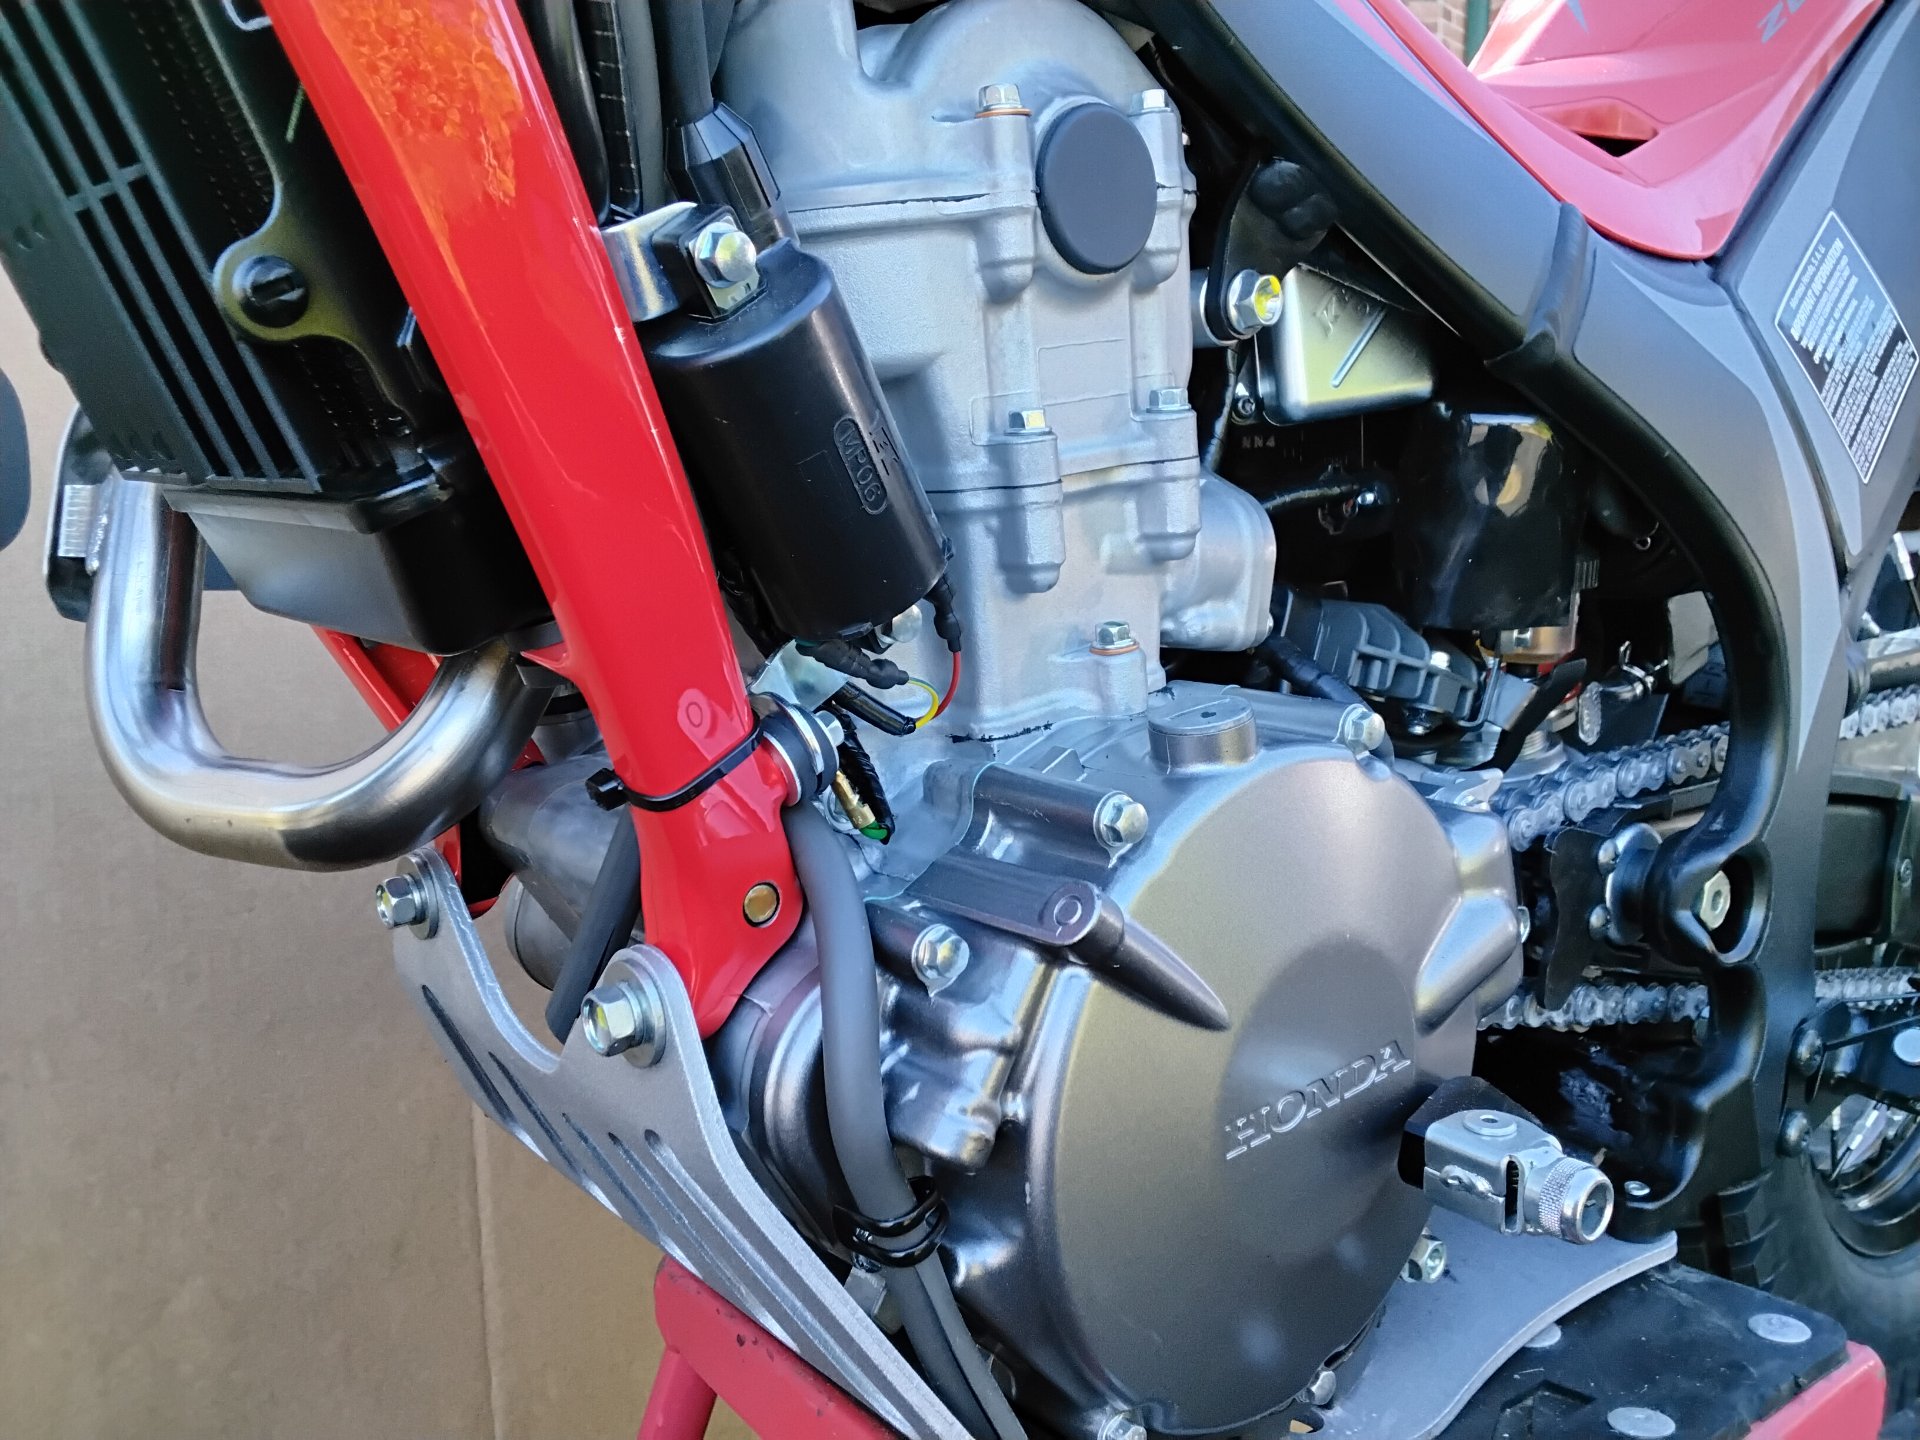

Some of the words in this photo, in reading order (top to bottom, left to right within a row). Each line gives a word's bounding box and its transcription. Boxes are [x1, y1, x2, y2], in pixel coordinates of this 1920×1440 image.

[1790, 288, 1817, 342] IMPORTANT
[1811, 237, 1845, 297] INFORMATION
[1224, 1040, 1412, 1160] HONDA
